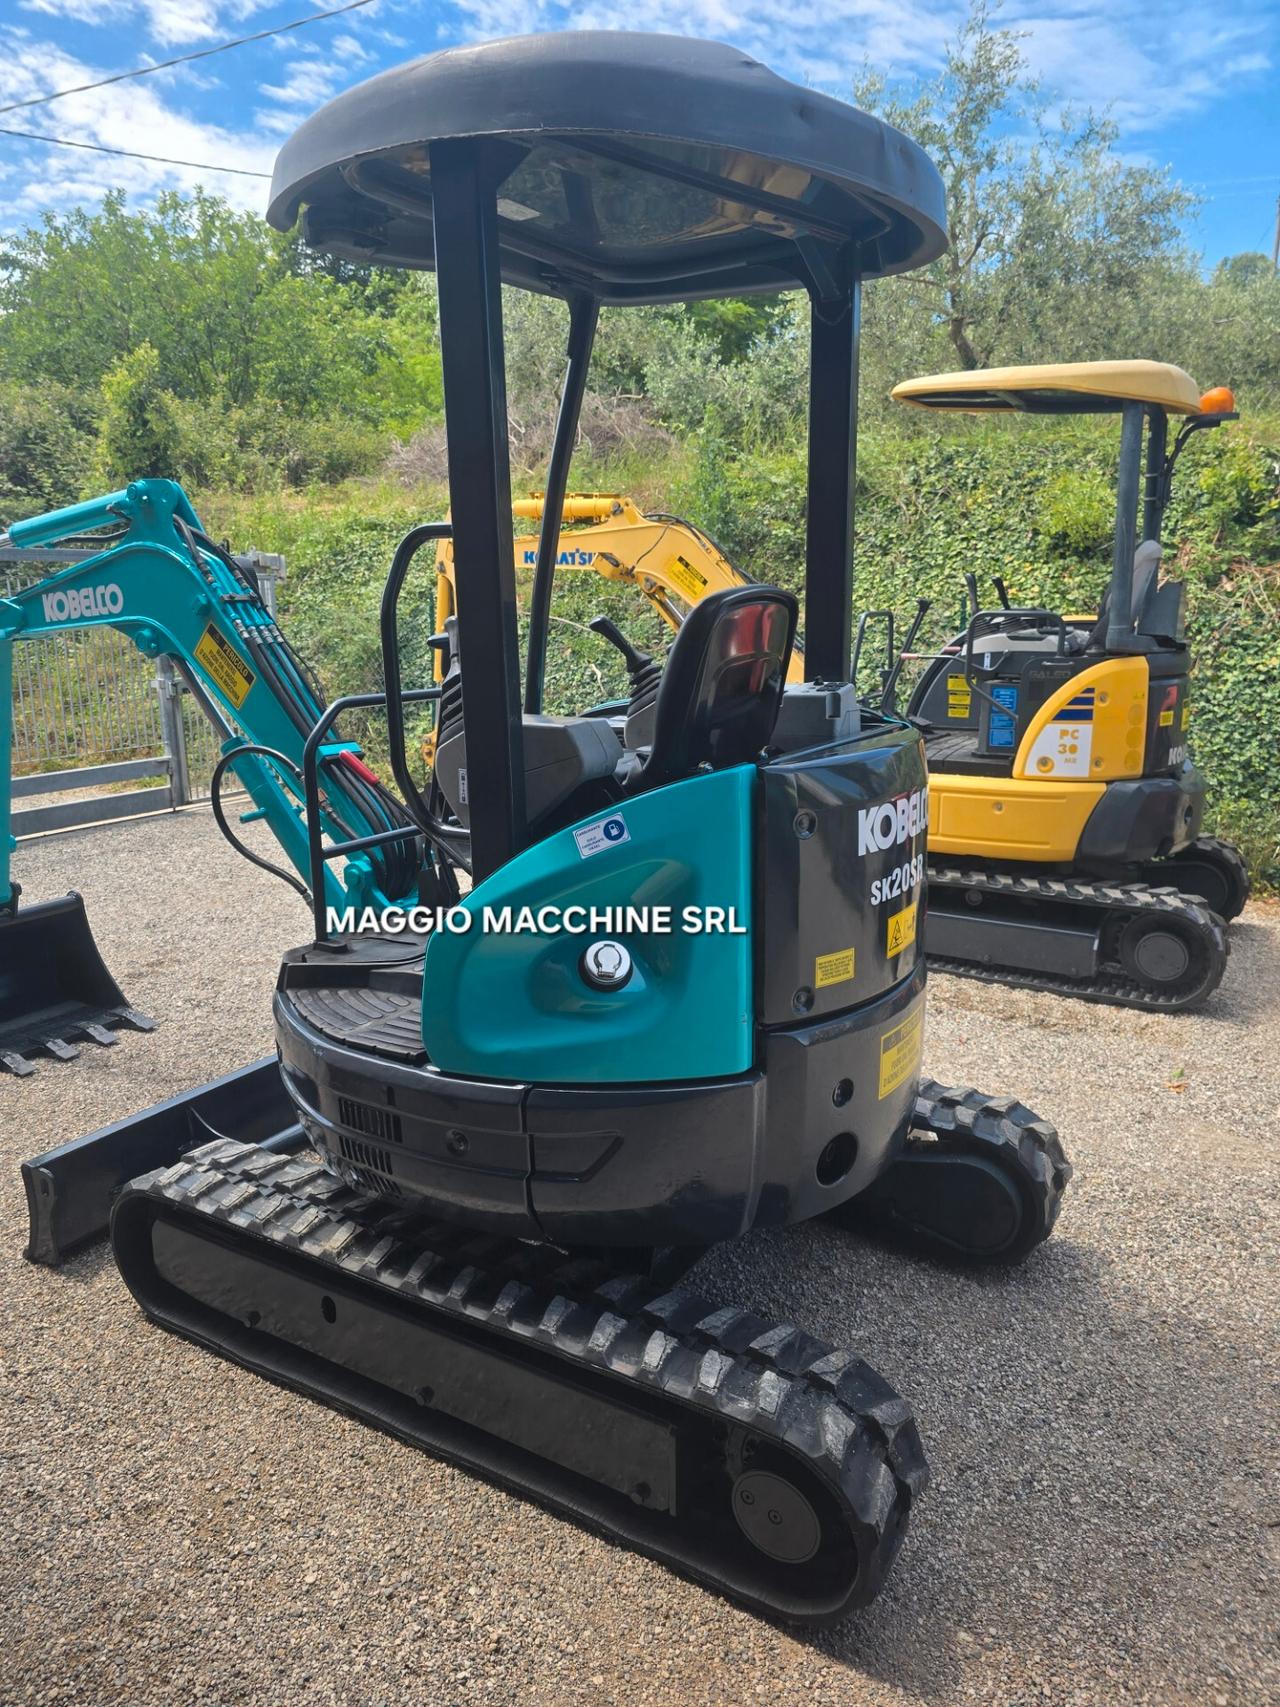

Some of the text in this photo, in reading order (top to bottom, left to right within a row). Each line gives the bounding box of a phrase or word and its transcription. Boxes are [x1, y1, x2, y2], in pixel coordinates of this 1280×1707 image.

[524, 548, 593, 565] KATS
[42, 583, 124, 622] KOBELCO
[222, 643, 249, 677] PERICOLO
[1058, 744, 1078, 754] 30
[1060, 729, 1079, 739] PC
[858, 788, 928, 857] KOBELC
[870, 853, 923, 906] SK20SR
